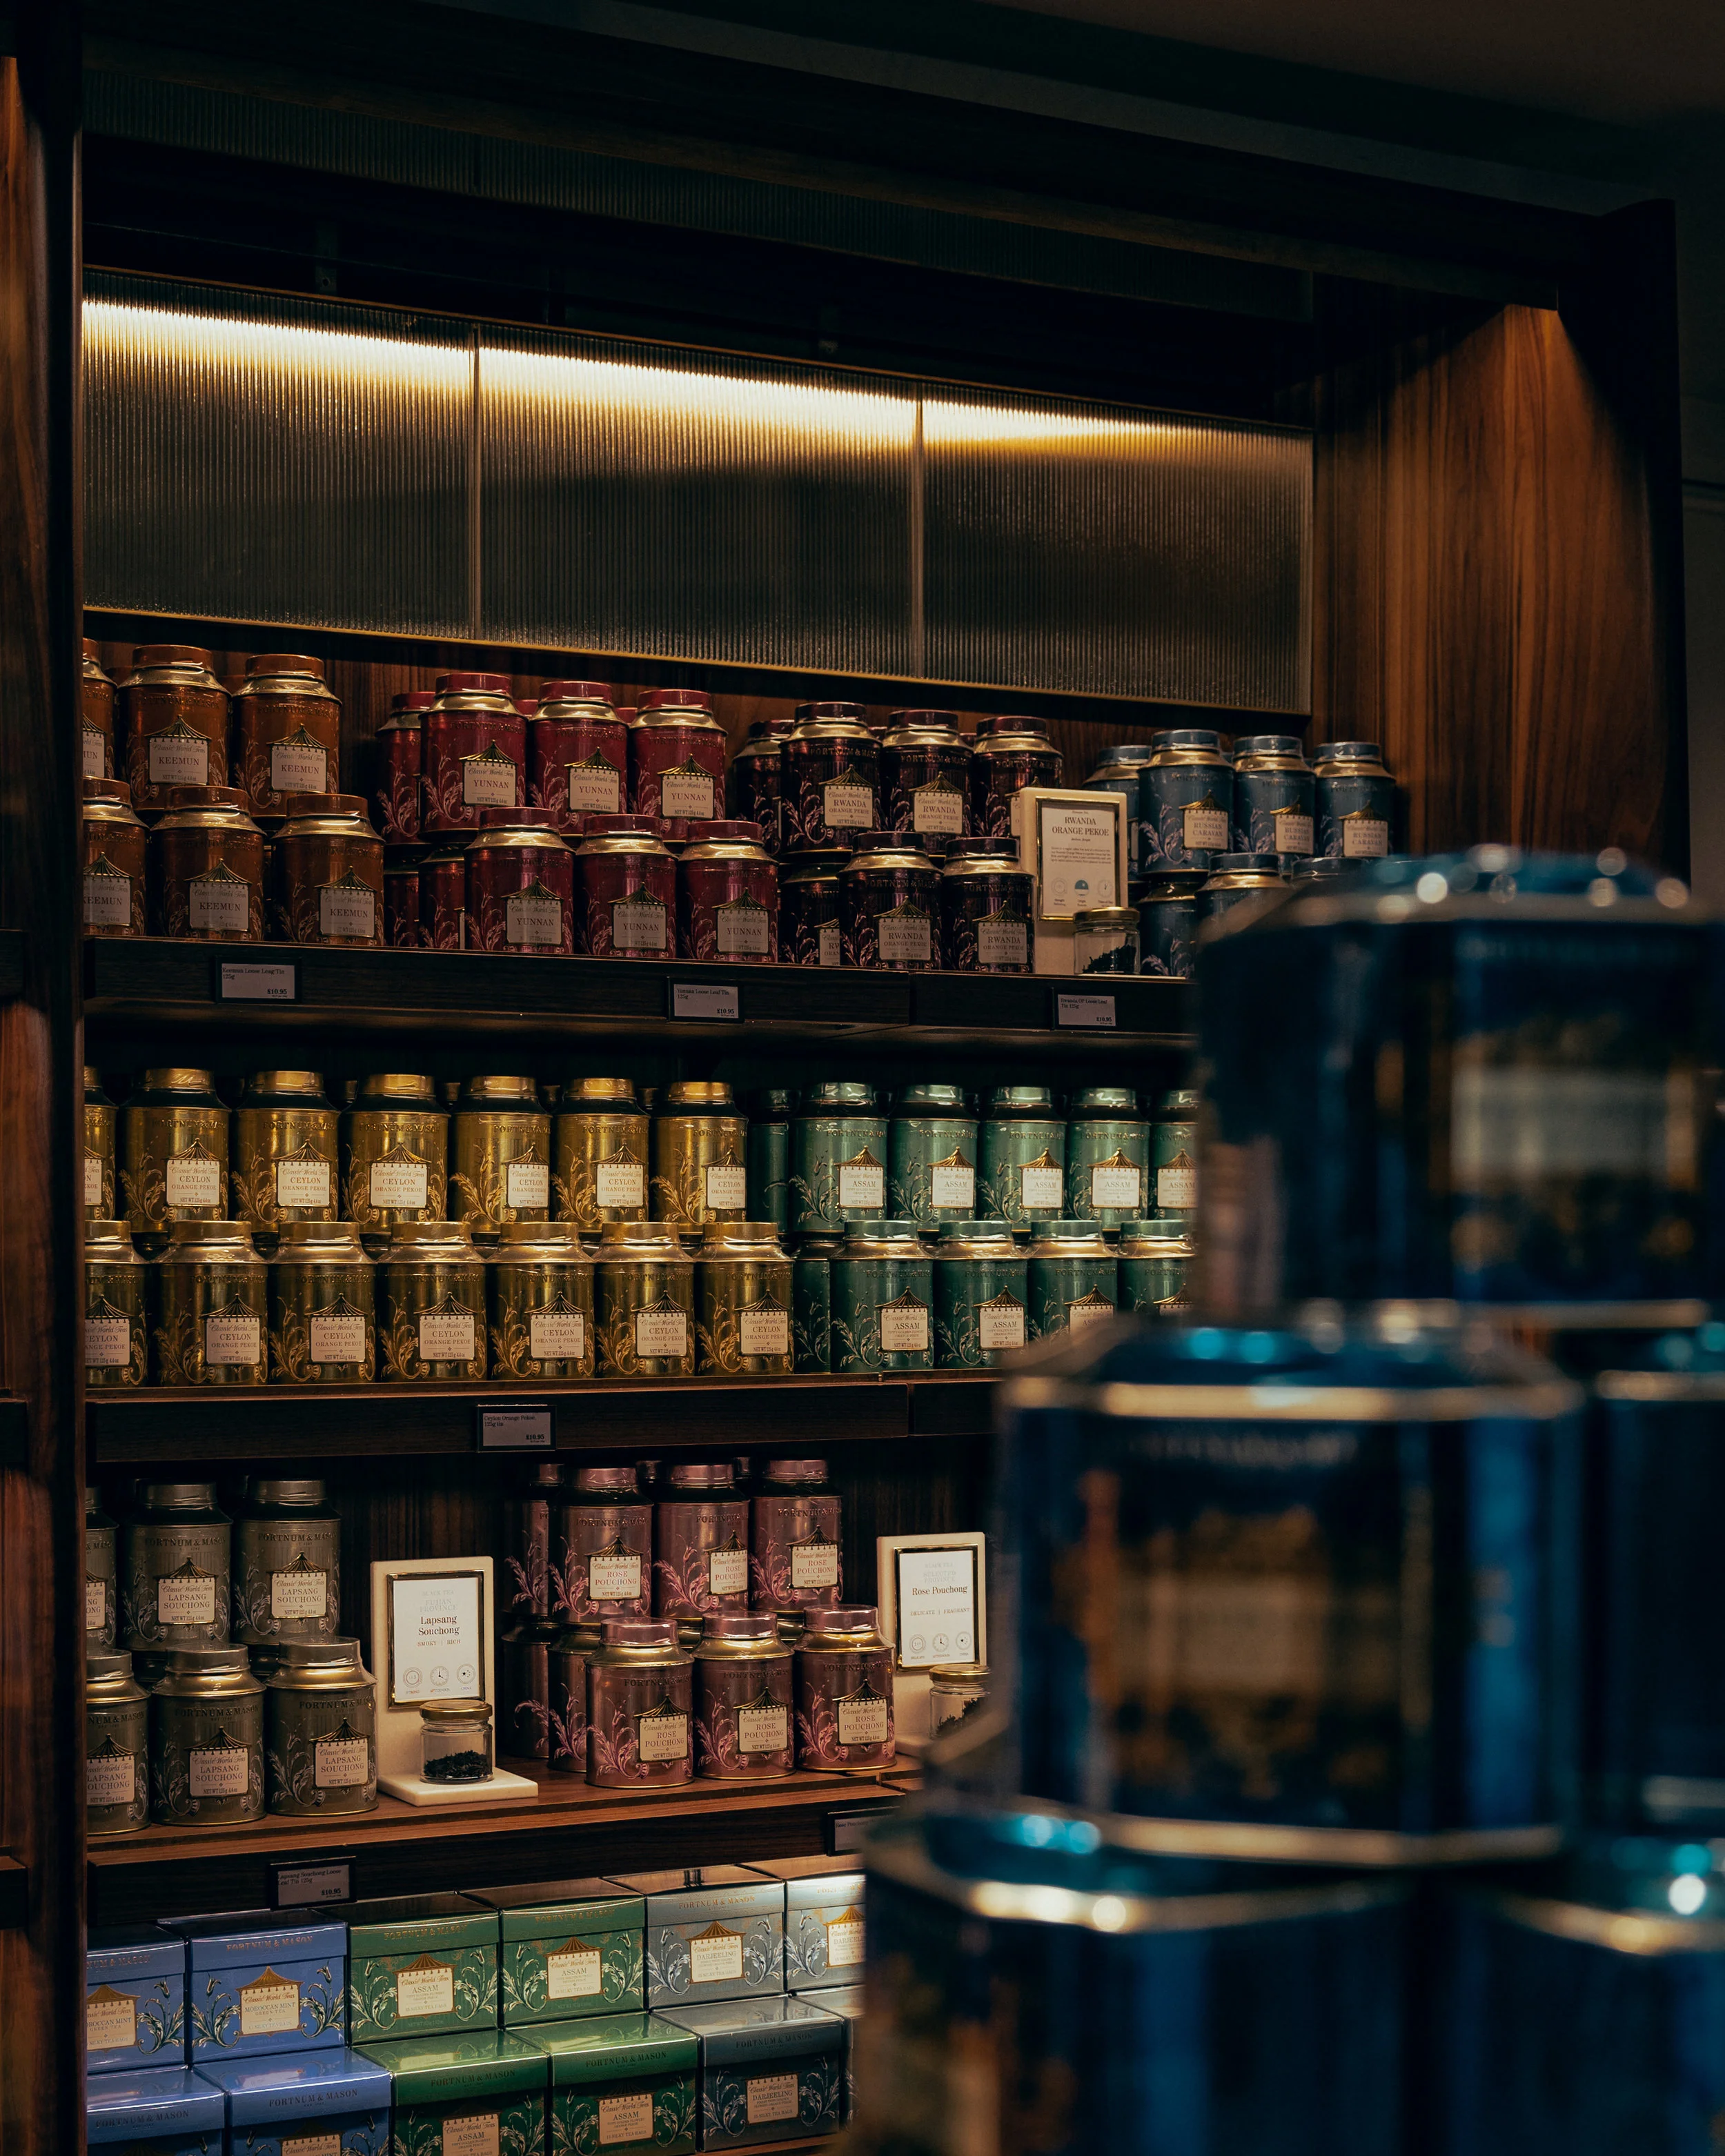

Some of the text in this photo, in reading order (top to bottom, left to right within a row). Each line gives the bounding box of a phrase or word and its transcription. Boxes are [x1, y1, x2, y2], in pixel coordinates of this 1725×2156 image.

[159, 757, 199, 766] KEEMUN
[281, 765, 319, 774] KEEMUN
[473, 779, 509, 788] YUNNAN
[580, 786, 613, 795] YUNNAN
[671, 792, 707, 801] YUNNAN
[834, 800, 867, 808] RWANDA
[923, 805, 956, 814] RWANDA
[1065, 816, 1096, 826] RWANDA
[1052, 826, 1109, 836] ORANGE PEKOE
[83, 897, 122, 906] KEEMUN
[199, 902, 241, 911] KEEMUN
[331, 909, 368, 918] KEEMUN
[516, 918, 554, 926] YUNNAN
[623, 923, 659, 931] YUNNAN
[727, 927, 762, 936] YUNNAN
[894, 1321, 920, 1330] ASSAM
[992, 1321, 1018, 1329] ASSAM
[258, 1533, 304, 1542] FORTNUM
[797, 1566, 834, 1575] POUCHONG
[715, 1572, 746, 1581] POUCHONG
[595, 1578, 637, 1586] POUCHONG
[912, 1585, 967, 1596] Rose Pouchong
[277, 1594, 322, 1603] SOUCHONG
[164, 1601, 210, 1610] SOUCHONG
[421, 1616, 457, 1625] Lapsang
[418, 1627, 460, 1636] Souchong
[299, 1701, 347, 1710] FORTNUM
[844, 1721, 883, 1730] POUCHONG
[744, 1730, 784, 1739] POUCHONG
[645, 1738, 684, 1747] POUCHONG
[200, 1765, 239, 1773] LAPSANG
[321, 1763, 364, 1773] SOUCHONG
[87, 1773, 126, 1781] LAPSANG
[196, 1773, 244, 1781] SOUCHONG
[679, 1895, 756, 1910] FORTNUM MASON
[226, 1936, 313, 1952] FORTNUM MASON
[696, 1950, 737, 1961] DARJEELING
[412, 1984, 439, 1992] ASSAM
[243, 1994, 264, 2004] Classic
[245, 2004, 277, 2012] MOROCCAN
[736, 2039, 776, 2049] FORTNUM
[586, 2056, 628, 2067] FORTNUM
[638, 2051, 667, 2061] MASON
[431, 2070, 516, 2087] FORTNUM & MASON
[269, 2095, 315, 2108] FORTNUM
[325, 2089, 358, 2101] MASON
[753, 2090, 793, 2101] DARJEELING
[155, 2110, 189, 2121] MASON
[613, 2111, 639, 2119] ASSAM
[446, 2125, 467, 2134] Classic
[468, 2124, 484, 2132] World
[457, 2132, 485, 2141] ASSAM
